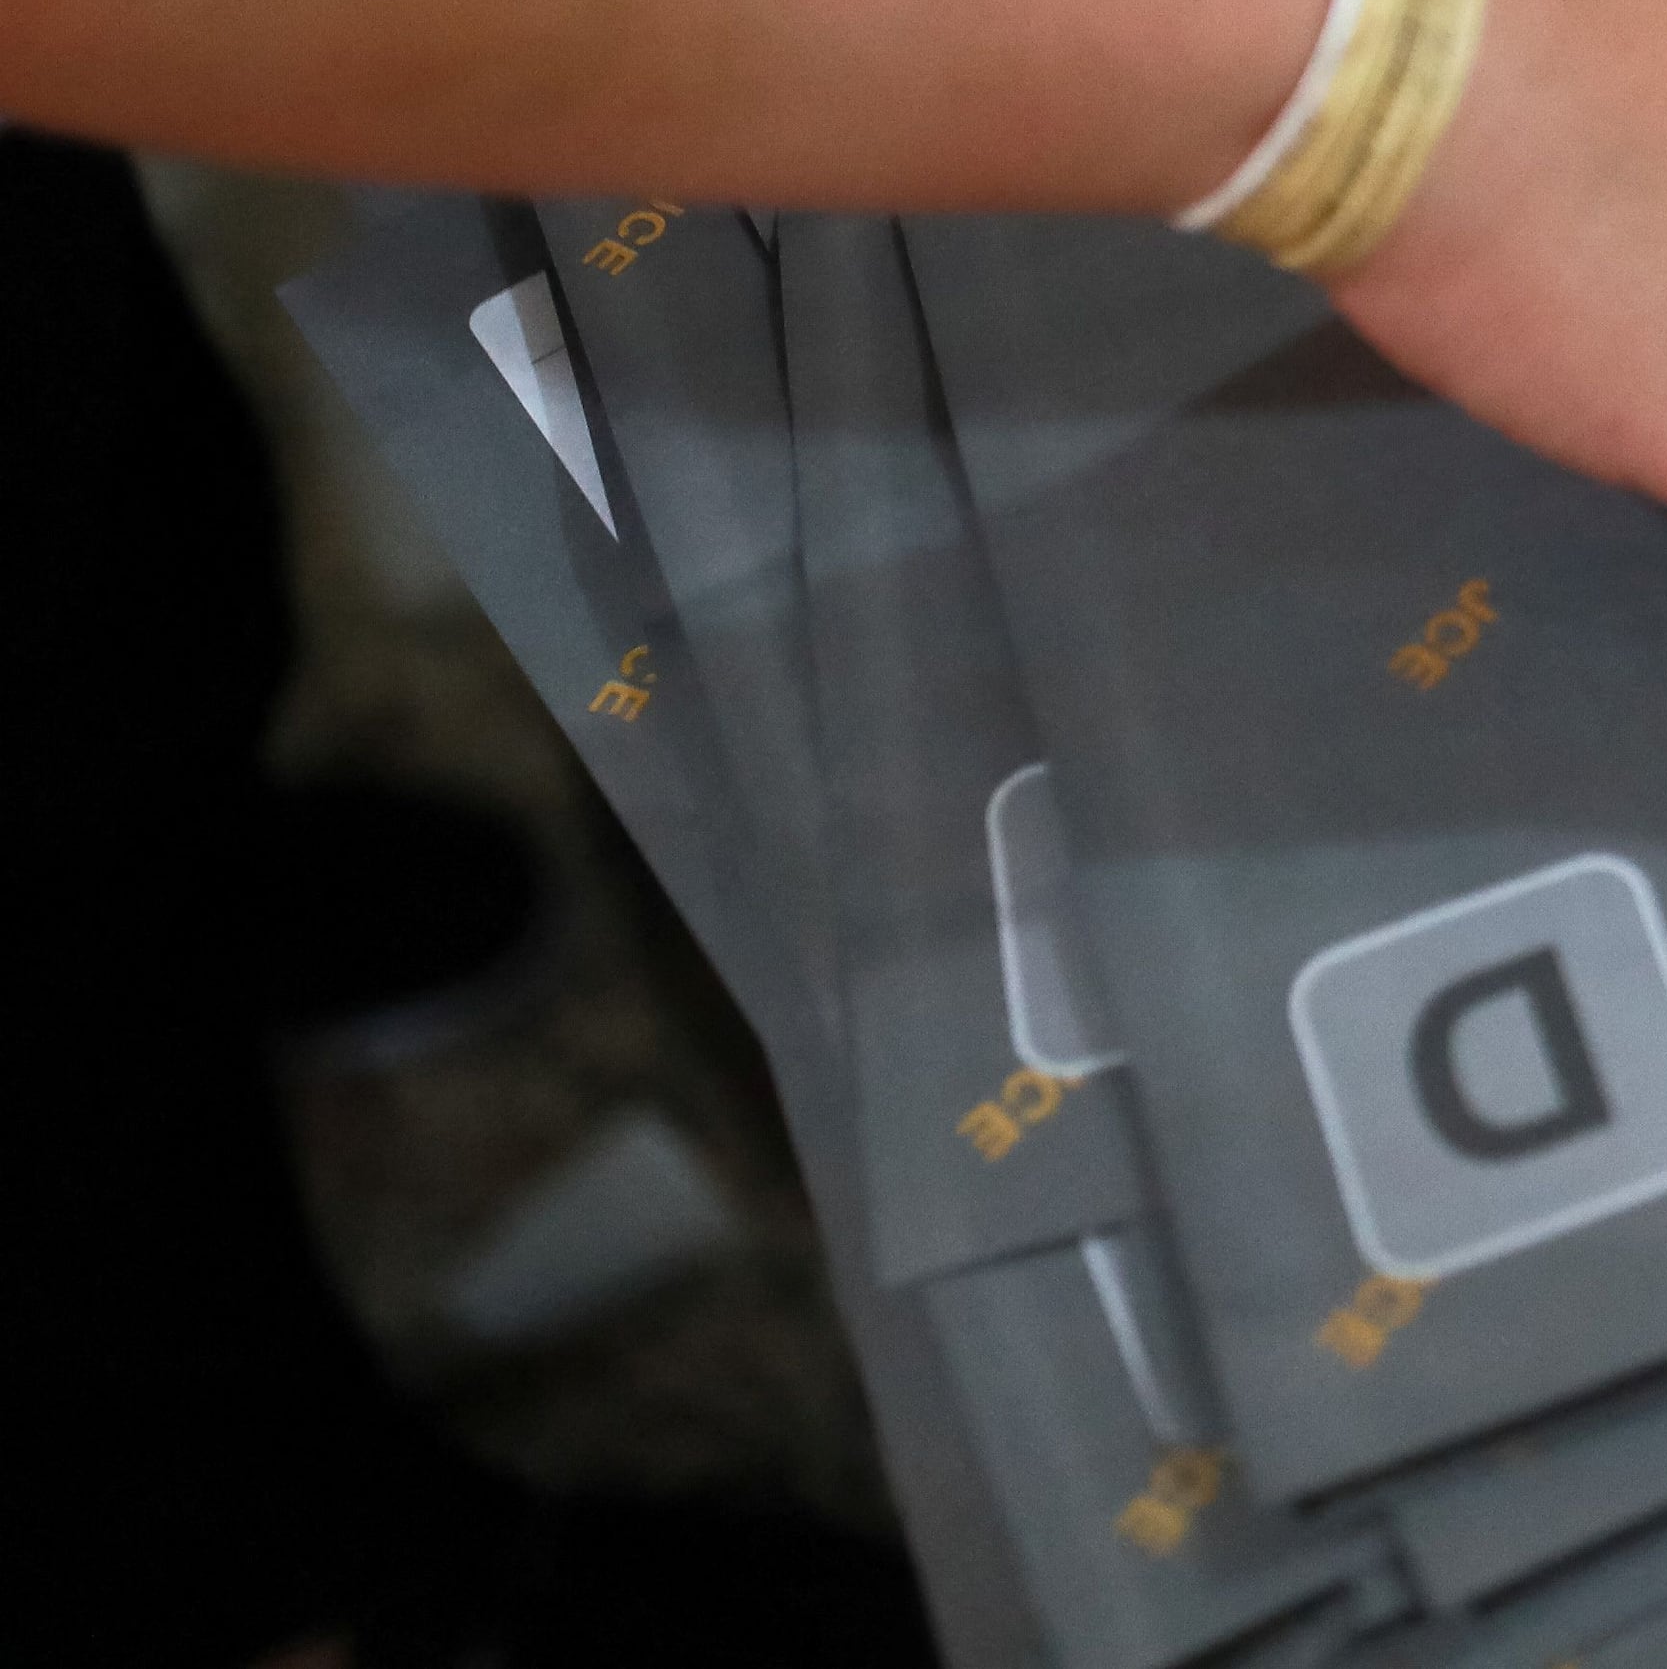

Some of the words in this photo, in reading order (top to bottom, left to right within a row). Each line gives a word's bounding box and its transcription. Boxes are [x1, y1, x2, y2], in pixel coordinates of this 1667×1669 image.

[1389, 577, 1498, 690] JCE
[1407, 942, 1614, 1167] D
[957, 1069, 1084, 1160] CE
